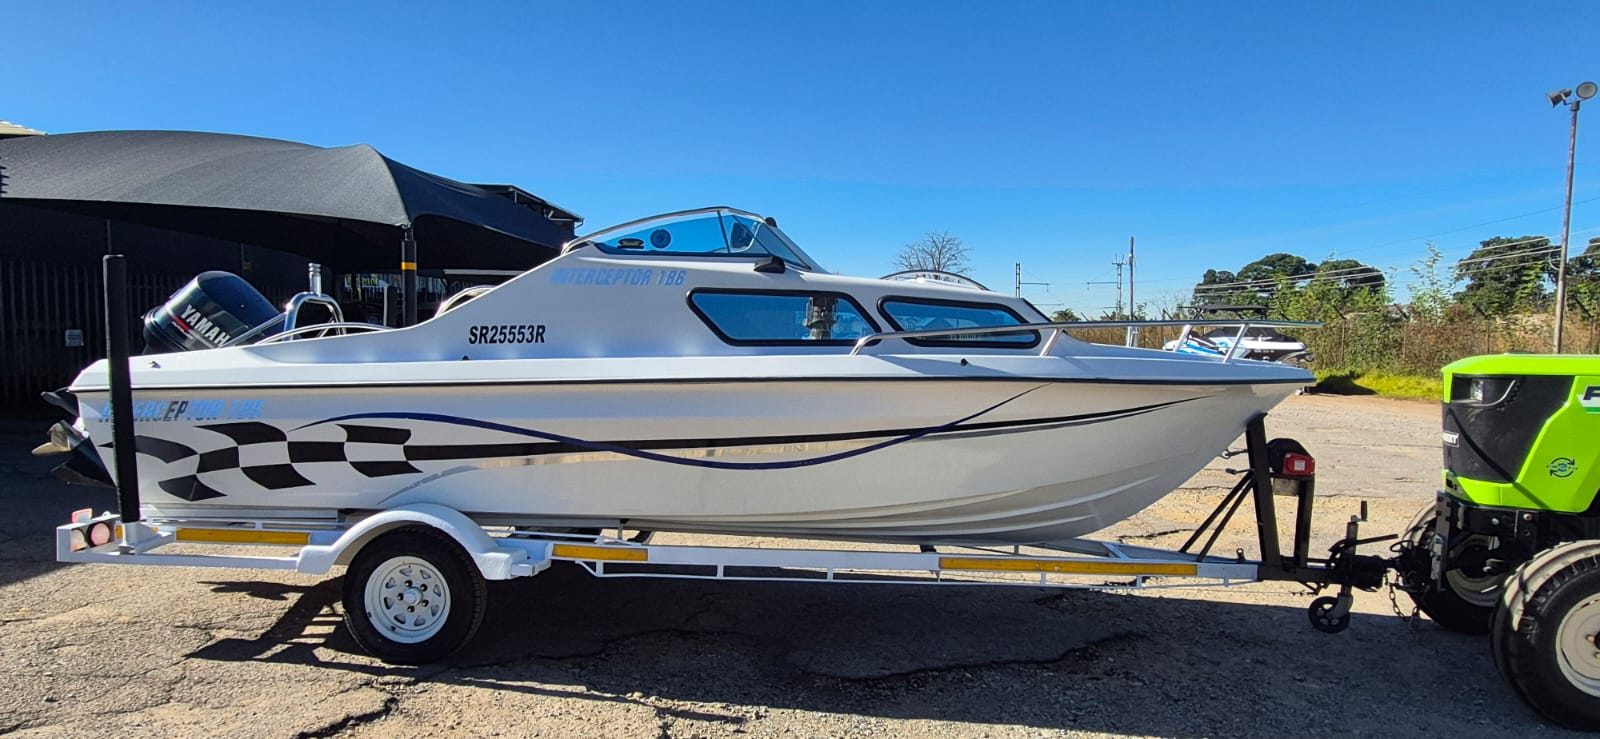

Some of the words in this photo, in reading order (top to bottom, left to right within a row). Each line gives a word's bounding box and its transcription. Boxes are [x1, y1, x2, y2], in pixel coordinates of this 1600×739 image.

[549, 267, 653, 286] INTERCEPTOR
[656, 268, 686, 286] 186
[180, 303, 231, 349] YAMAH
[468, 324, 546, 344] SR25553R
